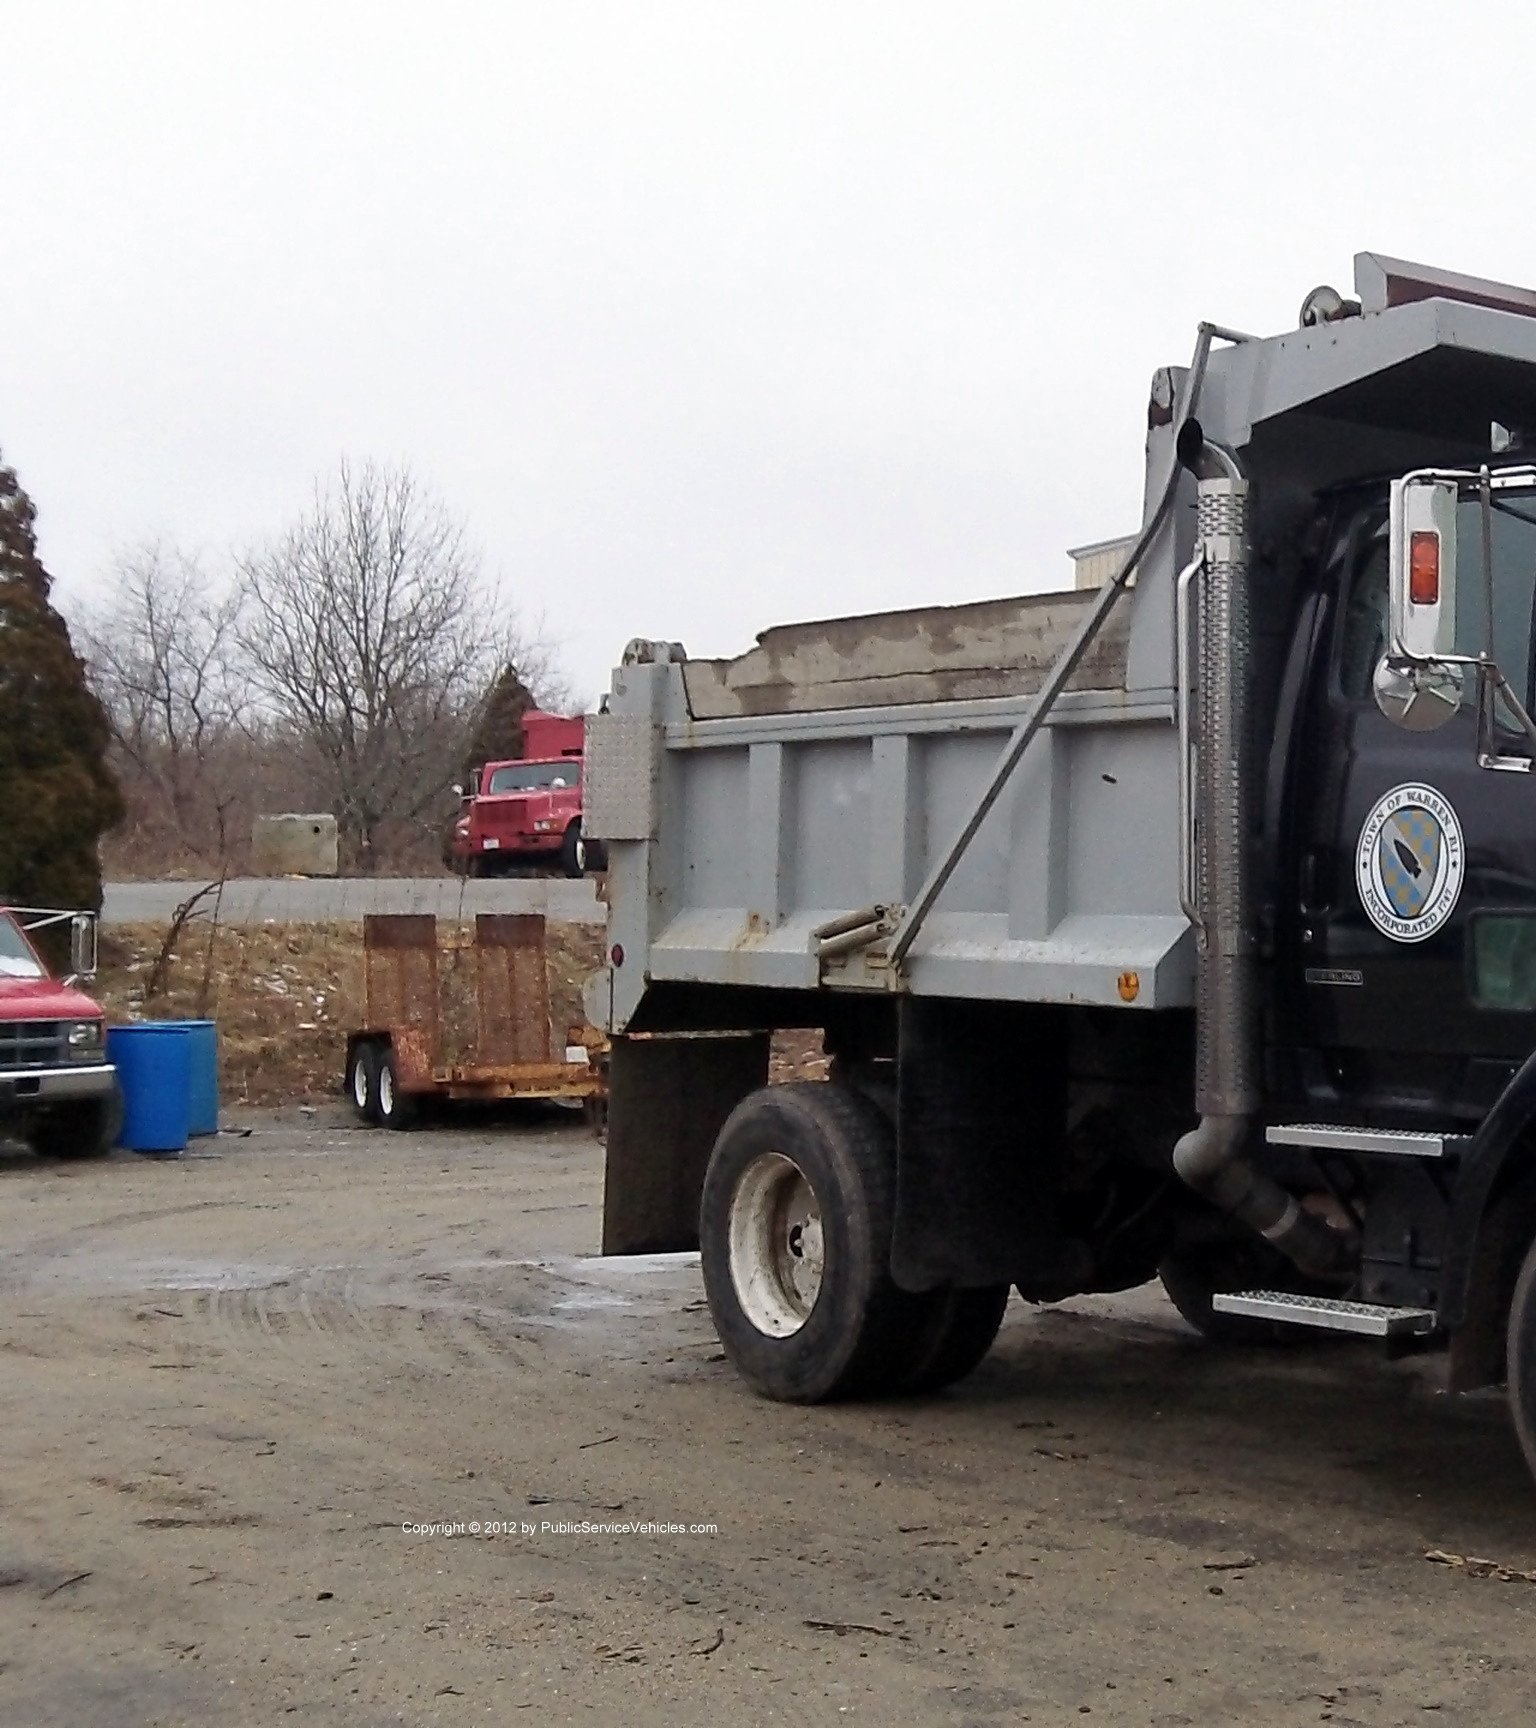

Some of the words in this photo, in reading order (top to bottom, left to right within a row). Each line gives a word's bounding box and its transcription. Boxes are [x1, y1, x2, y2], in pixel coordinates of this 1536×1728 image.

[1363, 809, 1385, 853] TOWN
[1387, 795, 1401, 810] OF
[1407, 791, 1451, 826] WARREN
[1448, 836, 1458, 853] RI
[1366, 889, 1438, 934] INCORPORATED
[1437, 888, 1453, 914] 1747
